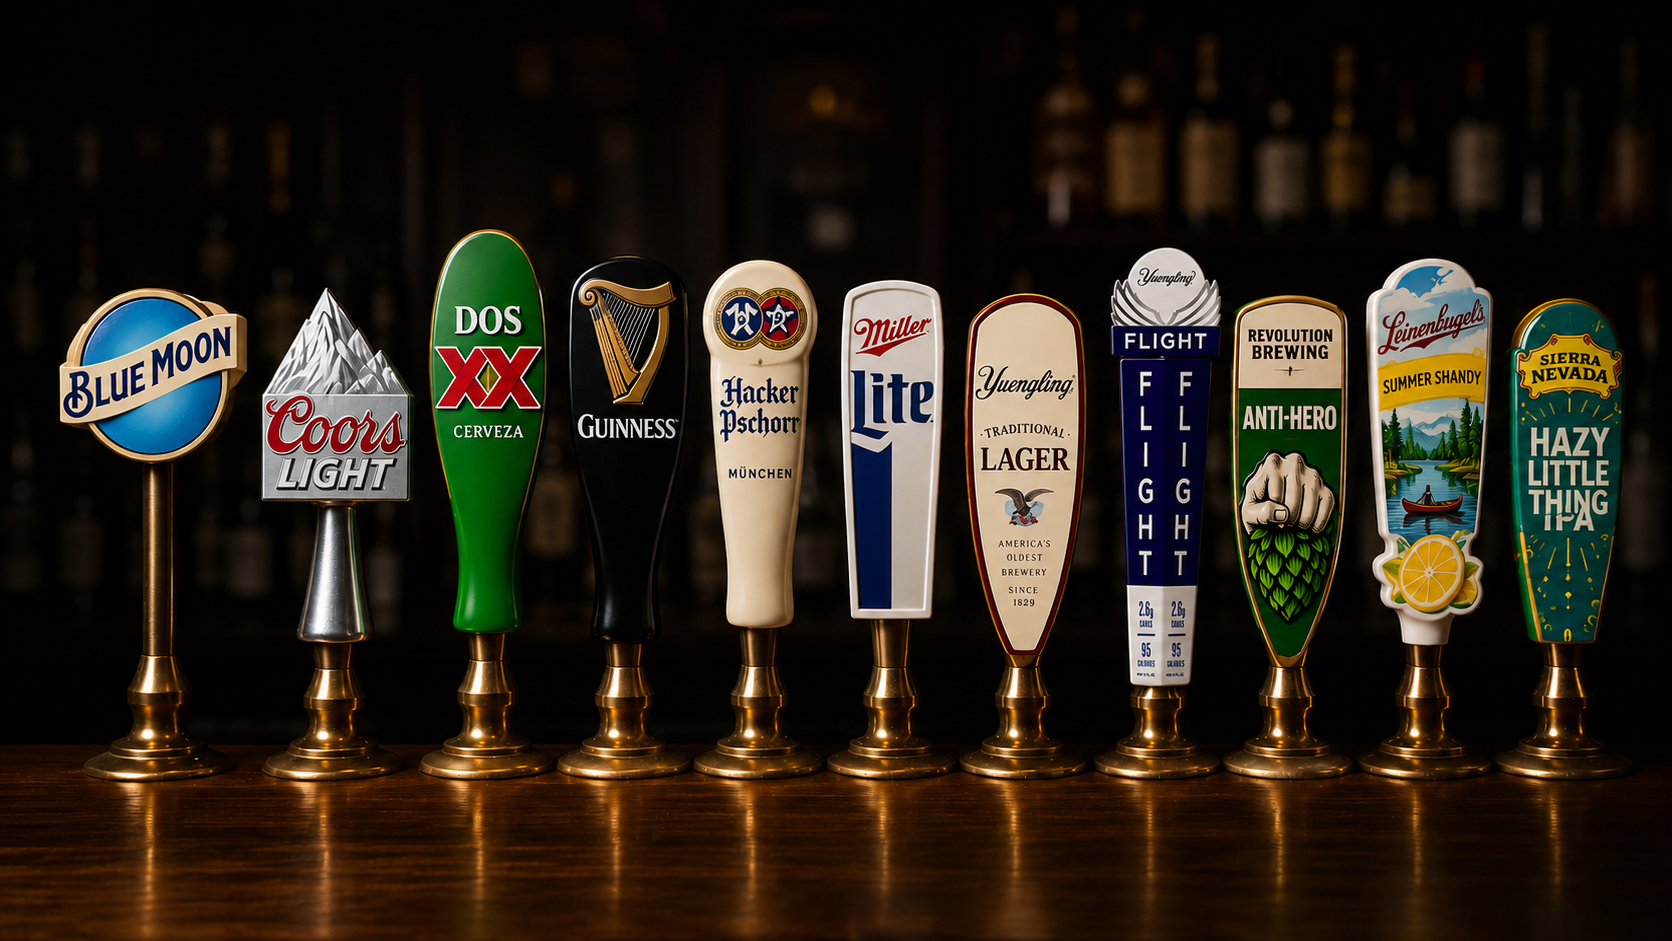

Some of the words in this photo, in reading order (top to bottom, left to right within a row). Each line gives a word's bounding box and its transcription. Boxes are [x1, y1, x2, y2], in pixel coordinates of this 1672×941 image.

[1137, 267, 1196, 286] Yuengling
[454, 305, 522, 335] DOS
[853, 315, 932, 350] Miller
[1124, 332, 1207, 349] FLIGHT
[1248, 329, 1333, 342] REVOLUTION
[1252, 345, 1329, 360] BREWING
[1539, 352, 1601, 367] SIERRA
[63, 360, 145, 418] BLUE
[151, 326, 232, 386] MOON
[434, 346, 542, 410] XX
[975, 365, 1074, 400] Yuengling
[1383, 370, 1432, 394] SUMMER
[1434, 369, 1482, 385] SHANDY
[1531, 368, 1608, 385] NEVADA
[720, 375, 800, 408] Hacker
[850, 370, 934, 440] Lite
[265, 395, 406, 454] Coors
[577, 413, 676, 439] GUINNESS
[719, 408, 800, 443] Pschorr
[1242, 405, 1337, 430] ANTI-HERO
[453, 425, 524, 438] CERVEZA
[984, 423, 1065, 438] TRADITIONAL
[1530, 427, 1610, 457] HAZY
[980, 447, 1070, 471] LAGER
[275, 457, 397, 491] LIGHT
[728, 466, 792, 479] MÜNCHEN
[1138, 371, 1154, 576] FLIGHT
[1174, 371, 1193, 576] FLIGHT
[1528, 460, 1609, 487] LITTLE
[1528, 489, 1608, 515] THING
[1544, 508, 1595, 531] IPA
[998, 540, 1051, 548] AMERICA'S
[1006, 553, 1043, 562] OLDEST
[1001, 568, 1047, 577] BREWERY
[1008, 586, 1038, 594] SINCE
[1013, 598, 1035, 607] 1829
[1141, 642, 1151, 657] 95
[1172, 642, 1181, 657] 95
